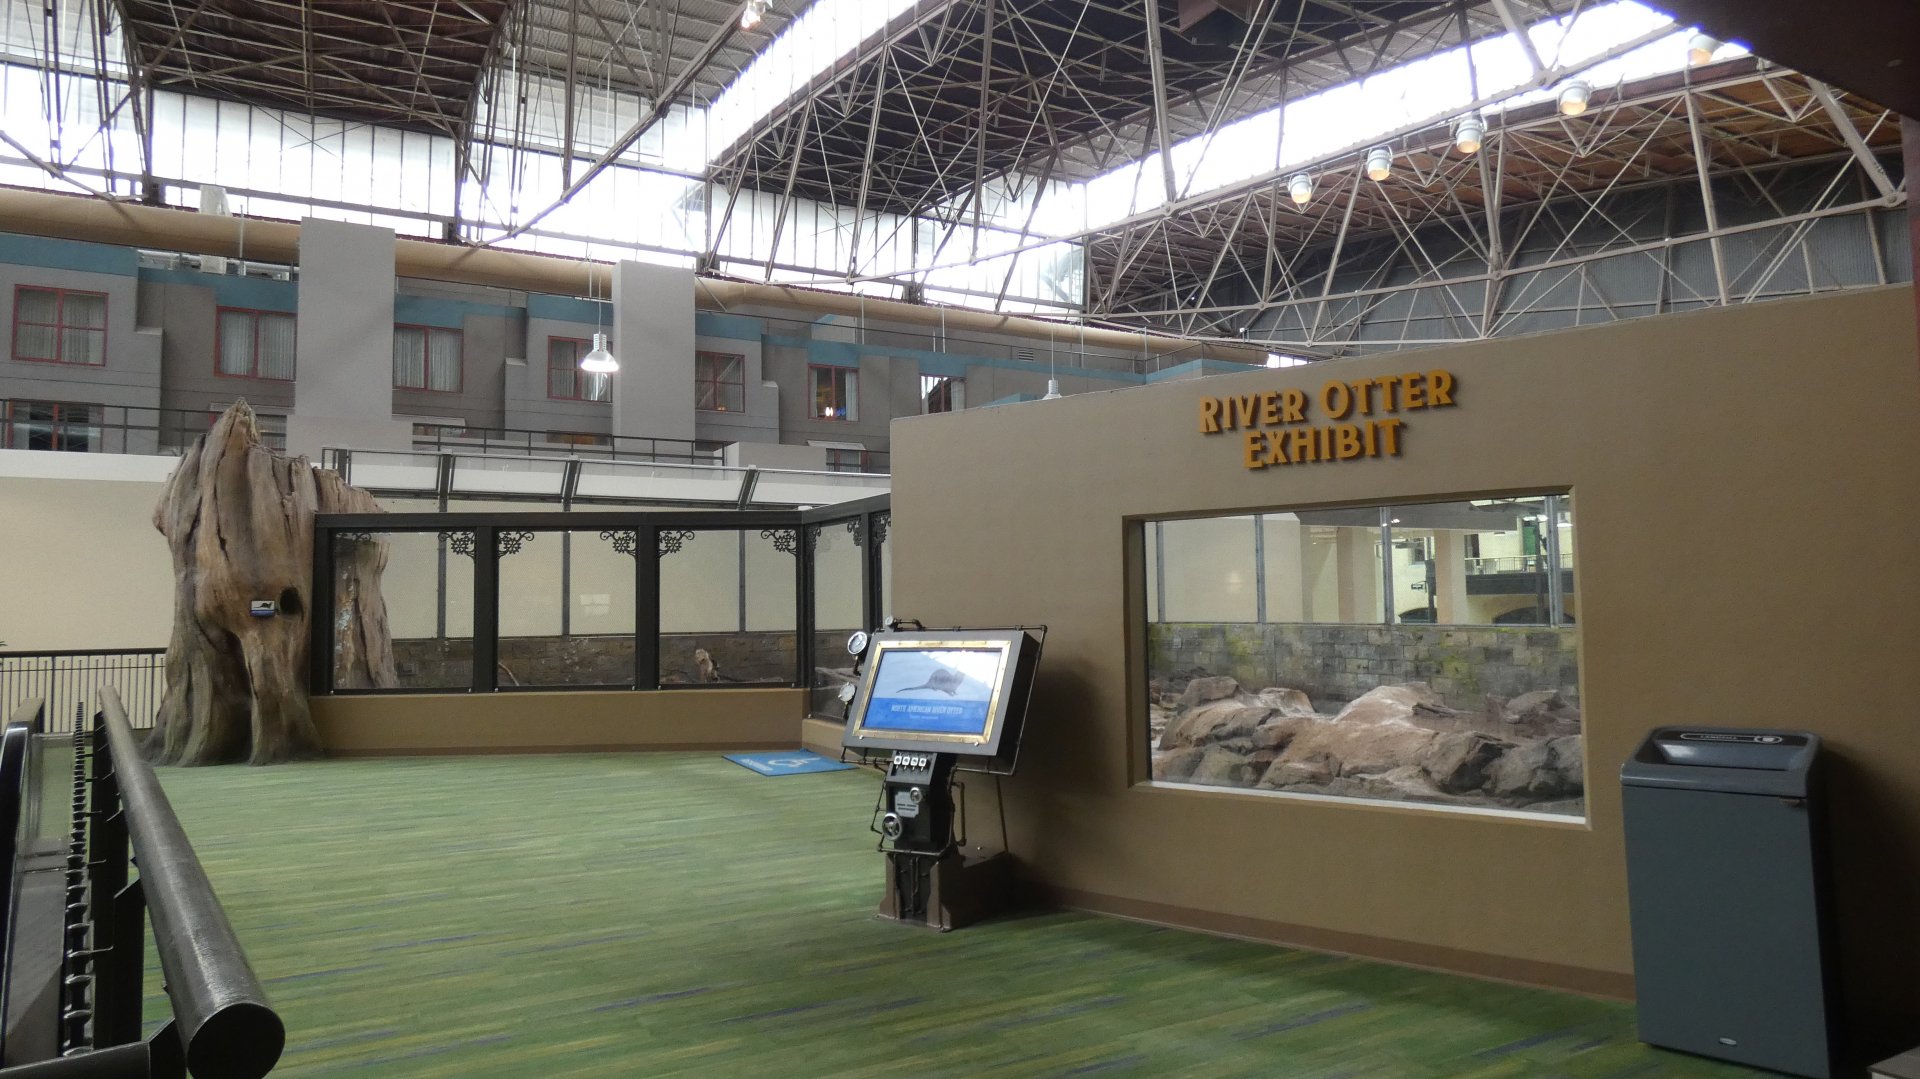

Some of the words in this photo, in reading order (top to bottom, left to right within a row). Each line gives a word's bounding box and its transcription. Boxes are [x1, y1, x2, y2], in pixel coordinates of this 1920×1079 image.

[1199, 387, 1305, 433] RIVER
[1318, 368, 1454, 420] OTTER
[1243, 417, 1402, 469] EXHIBIT
